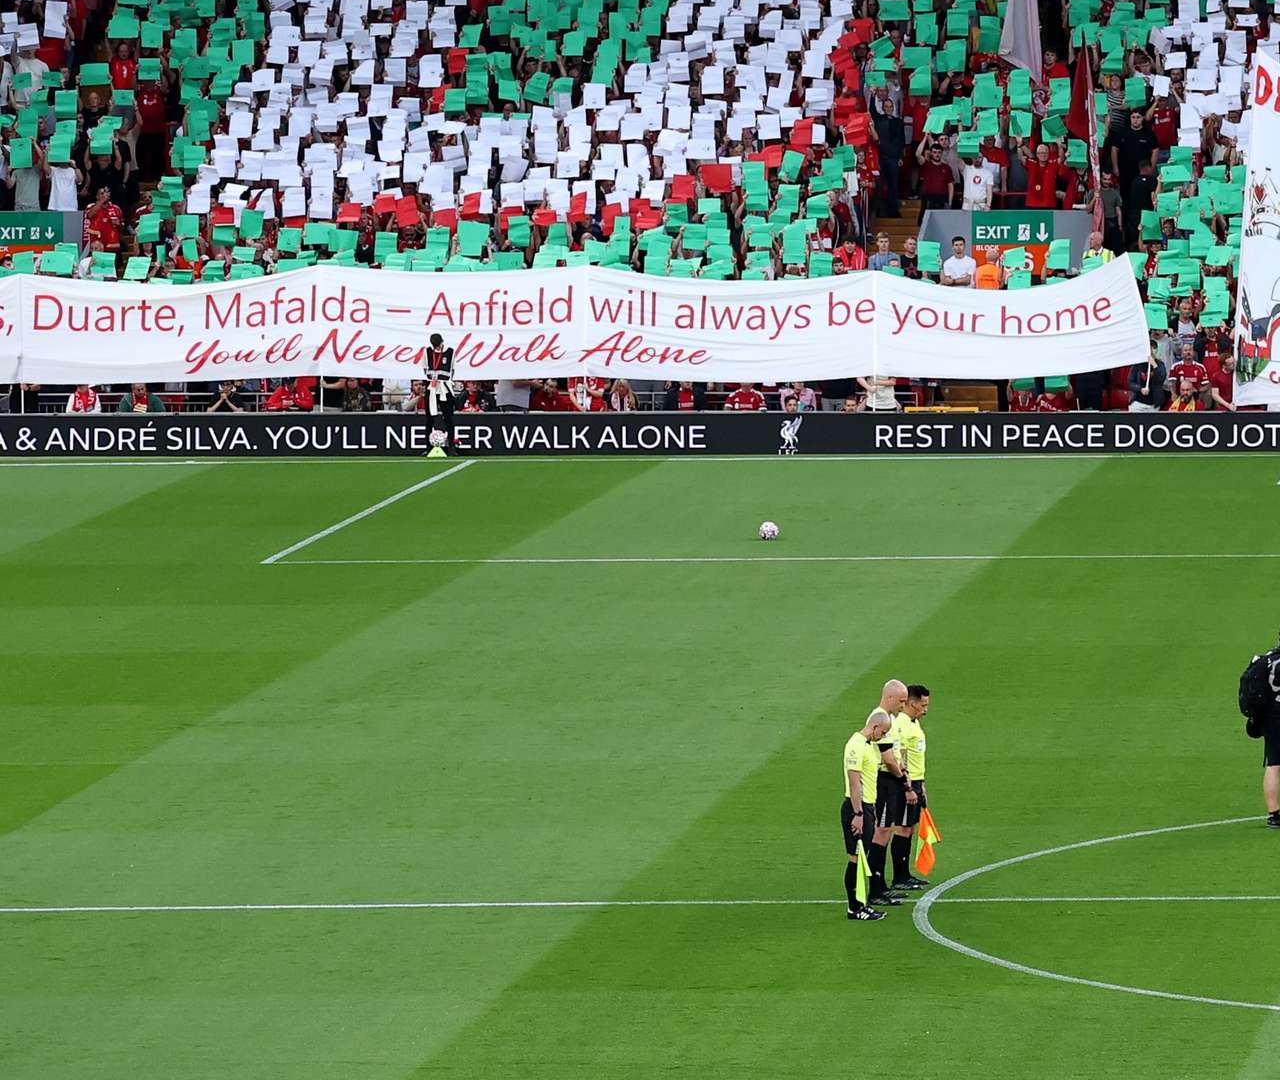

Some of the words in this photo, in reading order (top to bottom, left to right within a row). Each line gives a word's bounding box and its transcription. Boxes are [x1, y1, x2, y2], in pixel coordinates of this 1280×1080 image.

[976, 226, 1011, 239] EXIT
[33, 294, 184, 337] Duarte,
[205, 285, 371, 330] Mafalda
[425, 285, 573, 326] Anfield
[586, 289, 657, 326] will
[675, 296, 811, 340] always
[827, 291, 874, 326] be
[891, 300, 985, 336] your
[1001, 296, 1111, 335] home
[186, 334, 300, 375] You'll
[455, 333, 565, 366] Walk
[577, 330, 712, 367] Alone
[16, 427, 36, 451] &
[45, 421, 156, 451] ANDRÉ
[167, 427, 257, 450] SILVA.
[266, 426, 378, 449] YOU'LL
[386, 426, 492, 449] NEER
[502, 425, 590, 449] WALK
[597, 425, 706, 449] ALONE
[876, 425, 956, 448] REST
[963, 425, 991, 448] IN
[1004, 424, 1103, 448] PEACE
[1115, 424, 1220, 448] DIOGO
